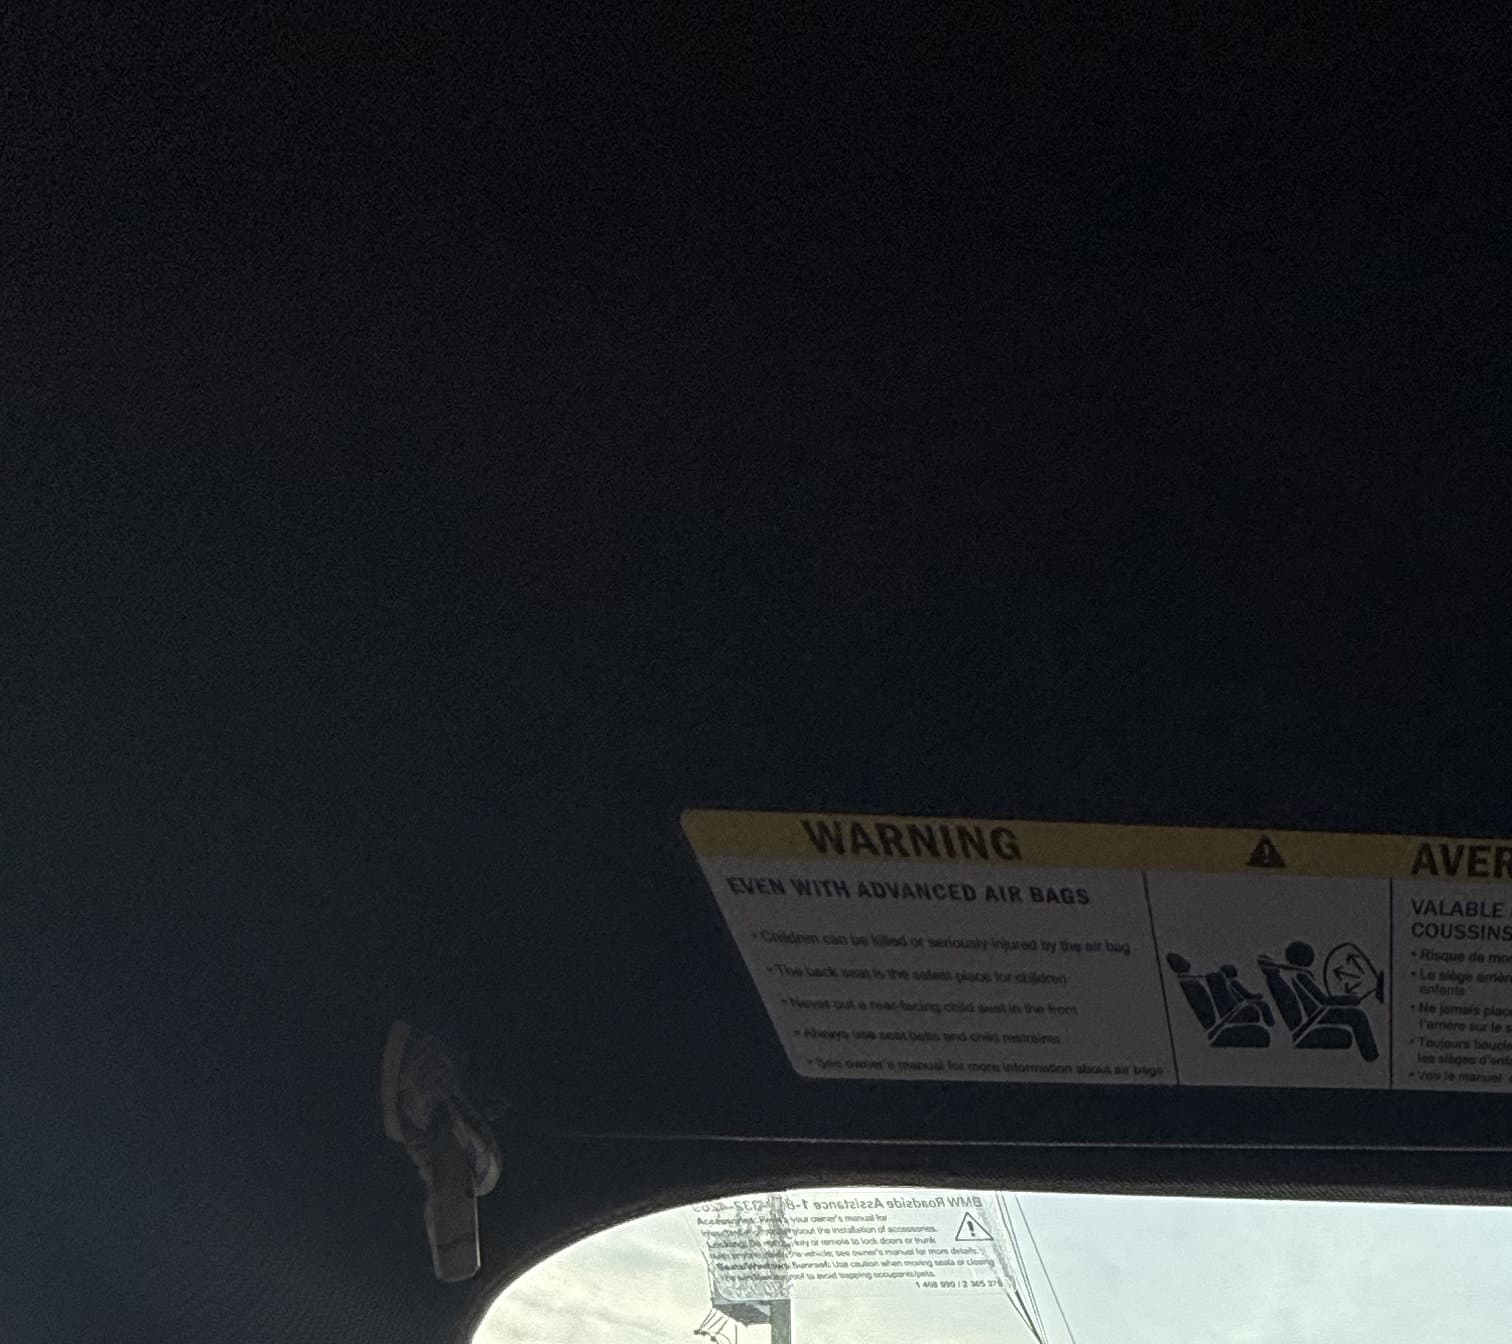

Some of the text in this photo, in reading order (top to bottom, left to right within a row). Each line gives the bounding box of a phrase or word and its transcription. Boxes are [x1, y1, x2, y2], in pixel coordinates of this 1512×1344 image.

[801, 819, 1022, 860] WARNING
[727, 878, 1090, 905] EVEN WITH ADVANCED AIR BAGS
[1411, 900, 1503, 918] VALABLE
